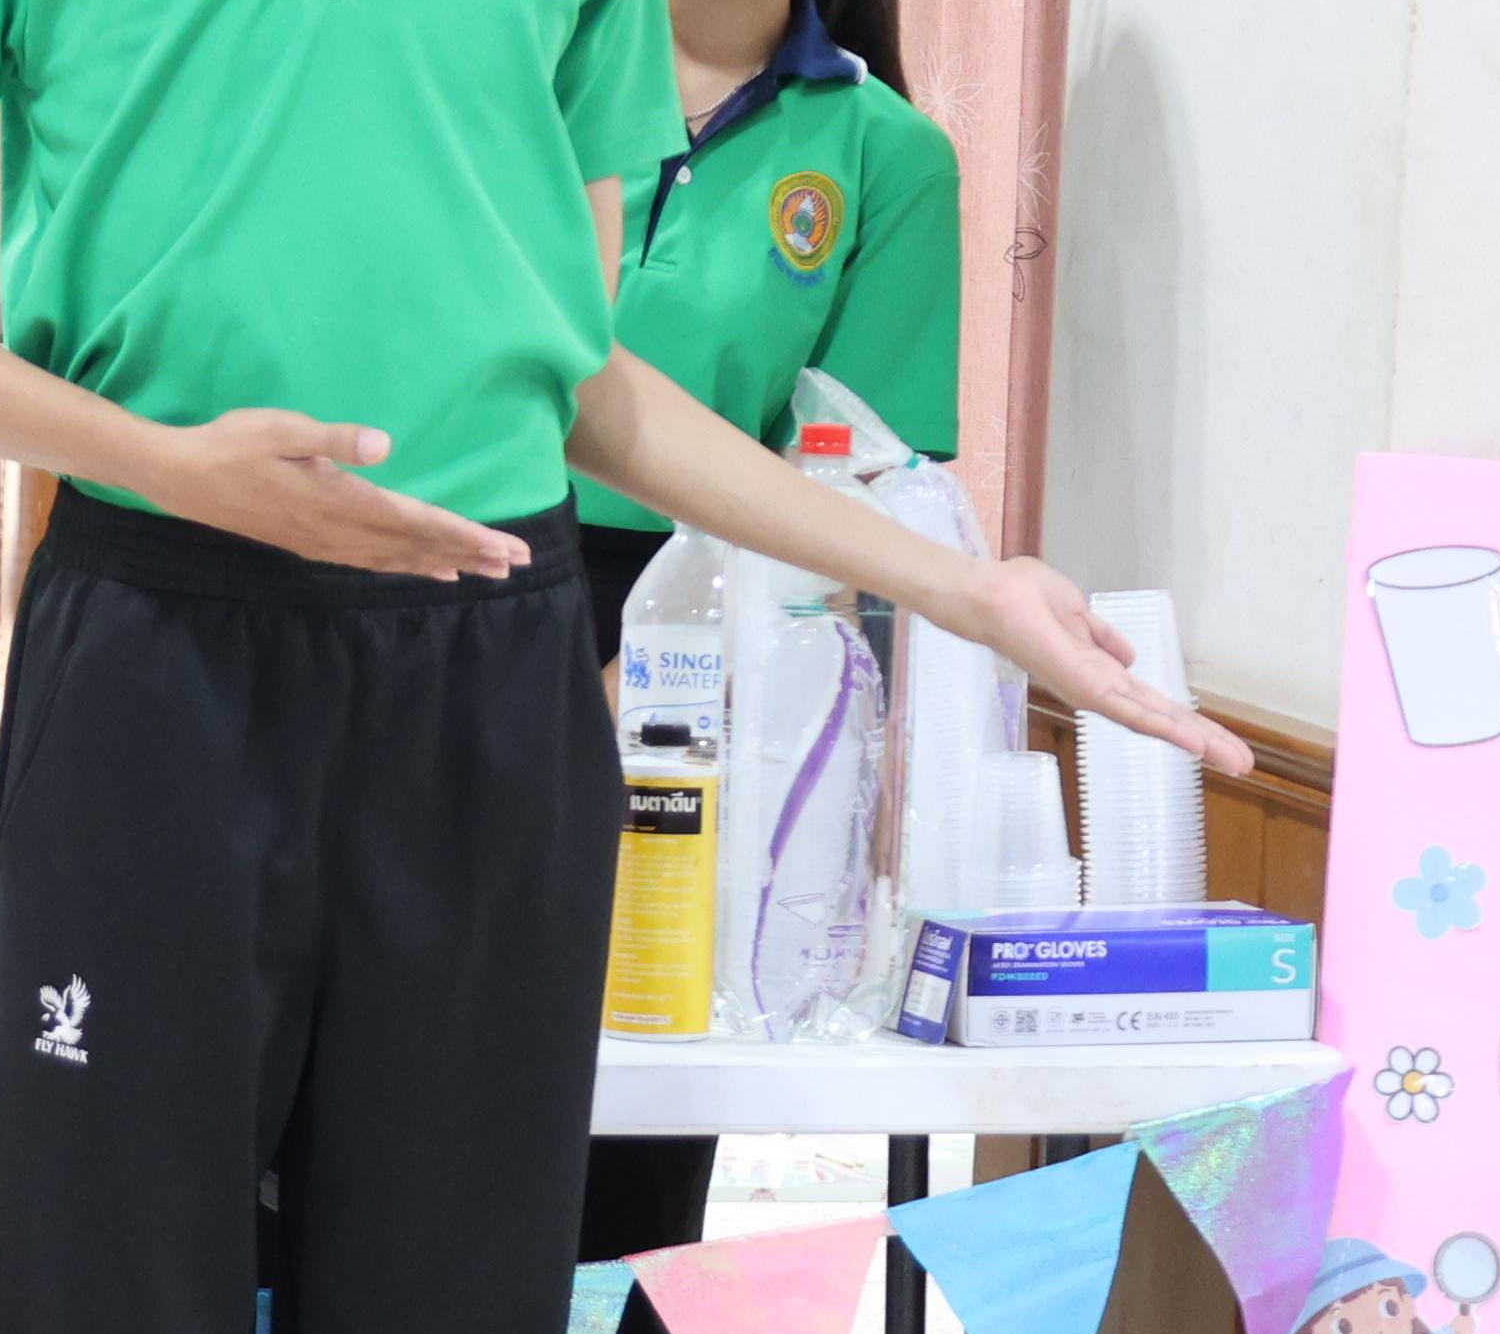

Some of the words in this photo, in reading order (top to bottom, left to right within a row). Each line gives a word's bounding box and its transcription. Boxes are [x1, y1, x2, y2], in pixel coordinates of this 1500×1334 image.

[1035, 939, 1108, 960] GLOVES
[1270, 947, 1298, 985] S
[34, 1037, 54, 1054] FLY
[54, 1041, 89, 1064] HAWK
